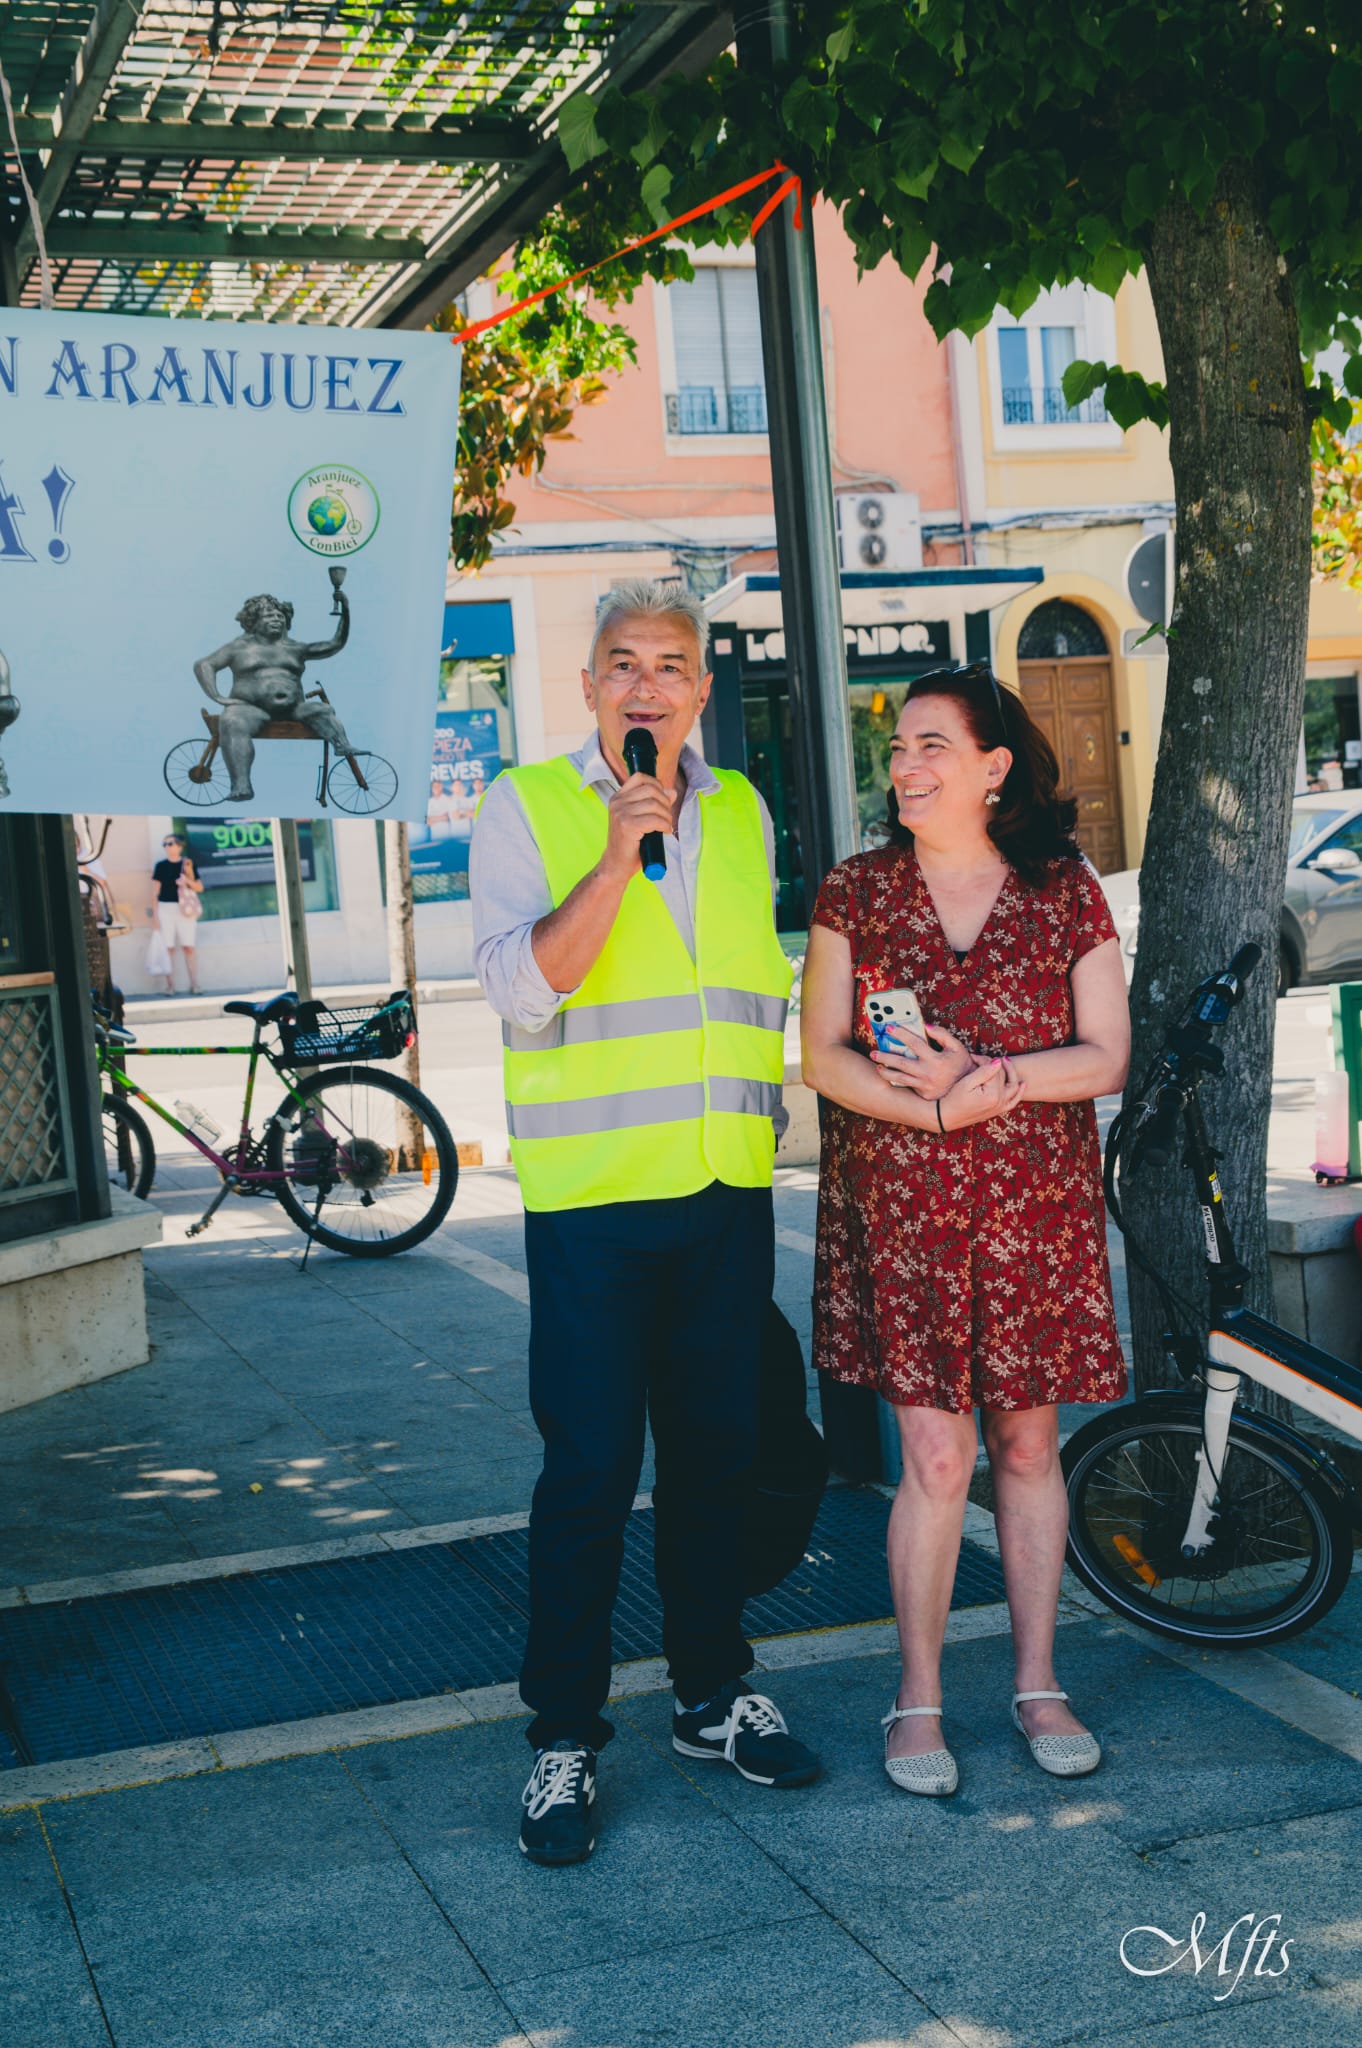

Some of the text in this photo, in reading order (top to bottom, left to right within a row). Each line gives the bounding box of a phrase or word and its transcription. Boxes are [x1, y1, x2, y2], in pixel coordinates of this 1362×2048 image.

[44, 340, 406, 416] ARANJUEZ
[308, 471, 361, 489] Aranjuez
[309, 537, 358, 552] ConBici
